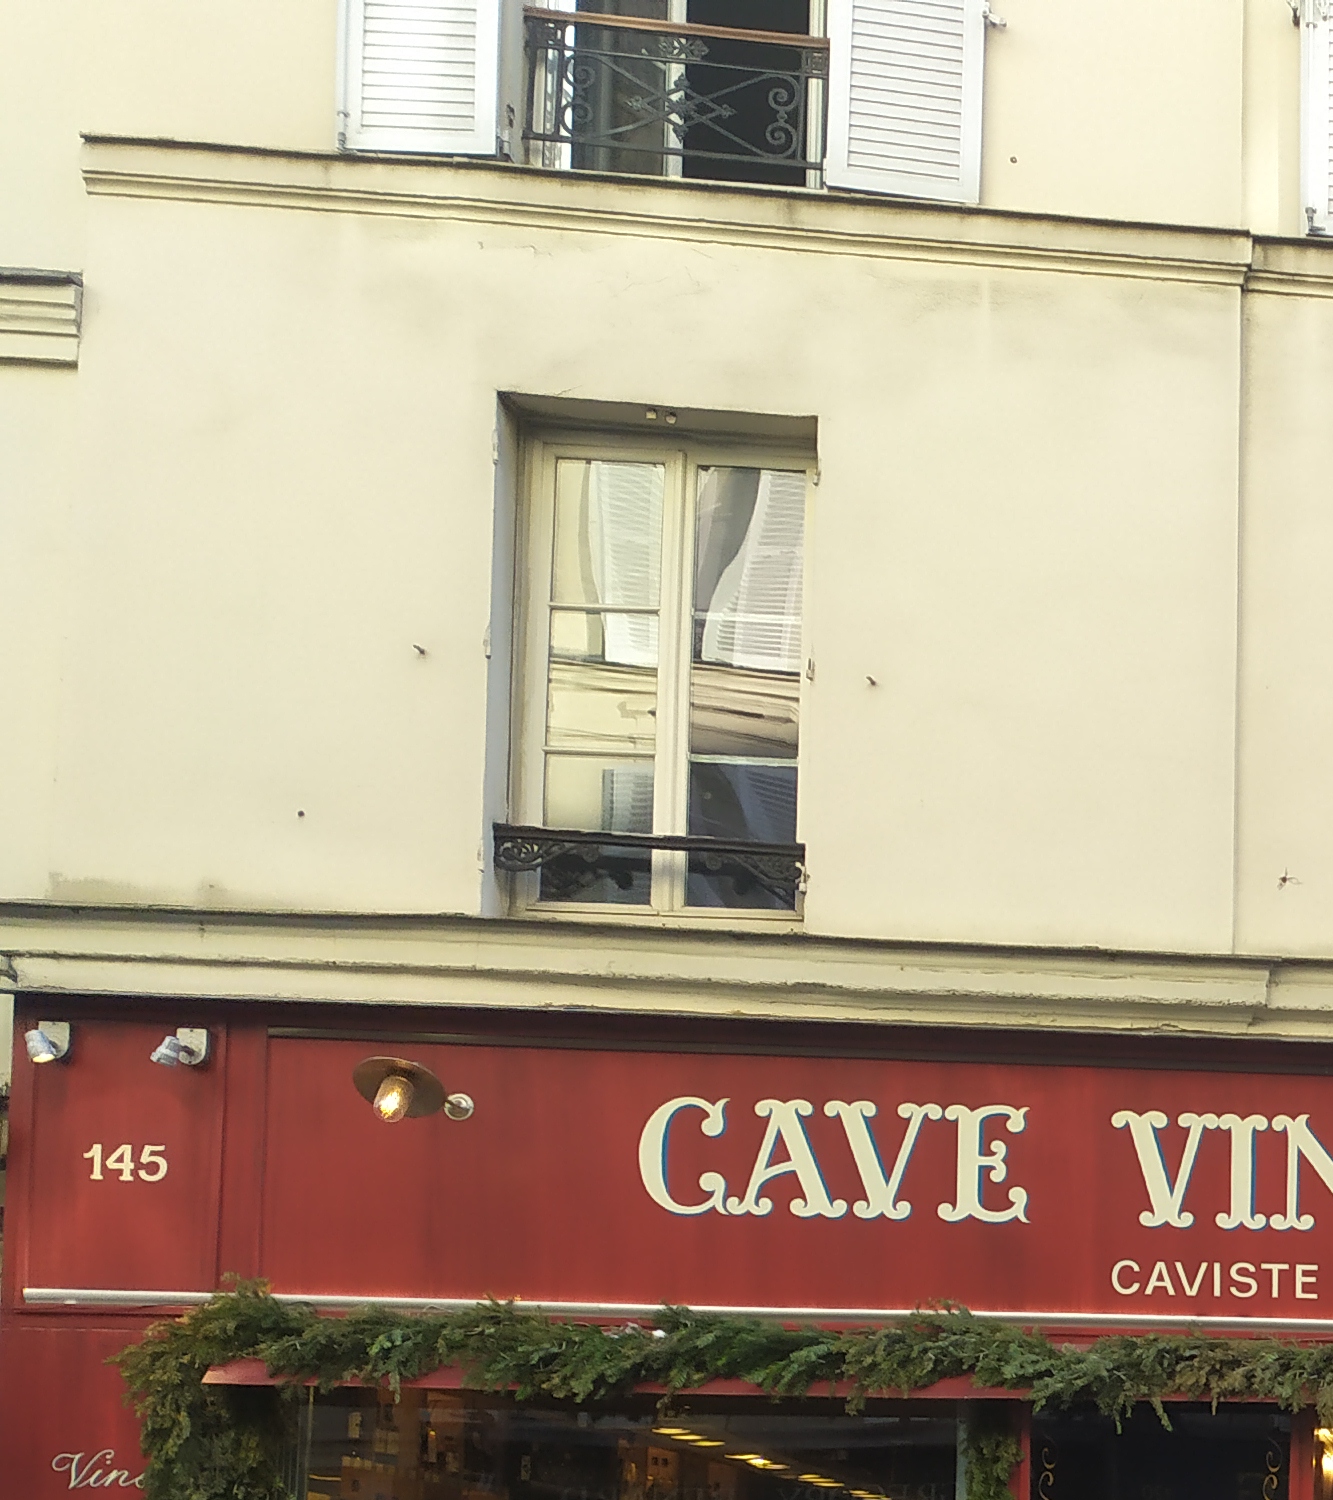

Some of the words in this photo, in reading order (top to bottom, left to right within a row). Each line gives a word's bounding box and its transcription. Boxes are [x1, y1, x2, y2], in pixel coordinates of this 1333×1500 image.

[83, 1143, 168, 1182] 145
[637, 1095, 1031, 1224] CAVE
[1110, 1259, 1319, 1299] CAVISTE
